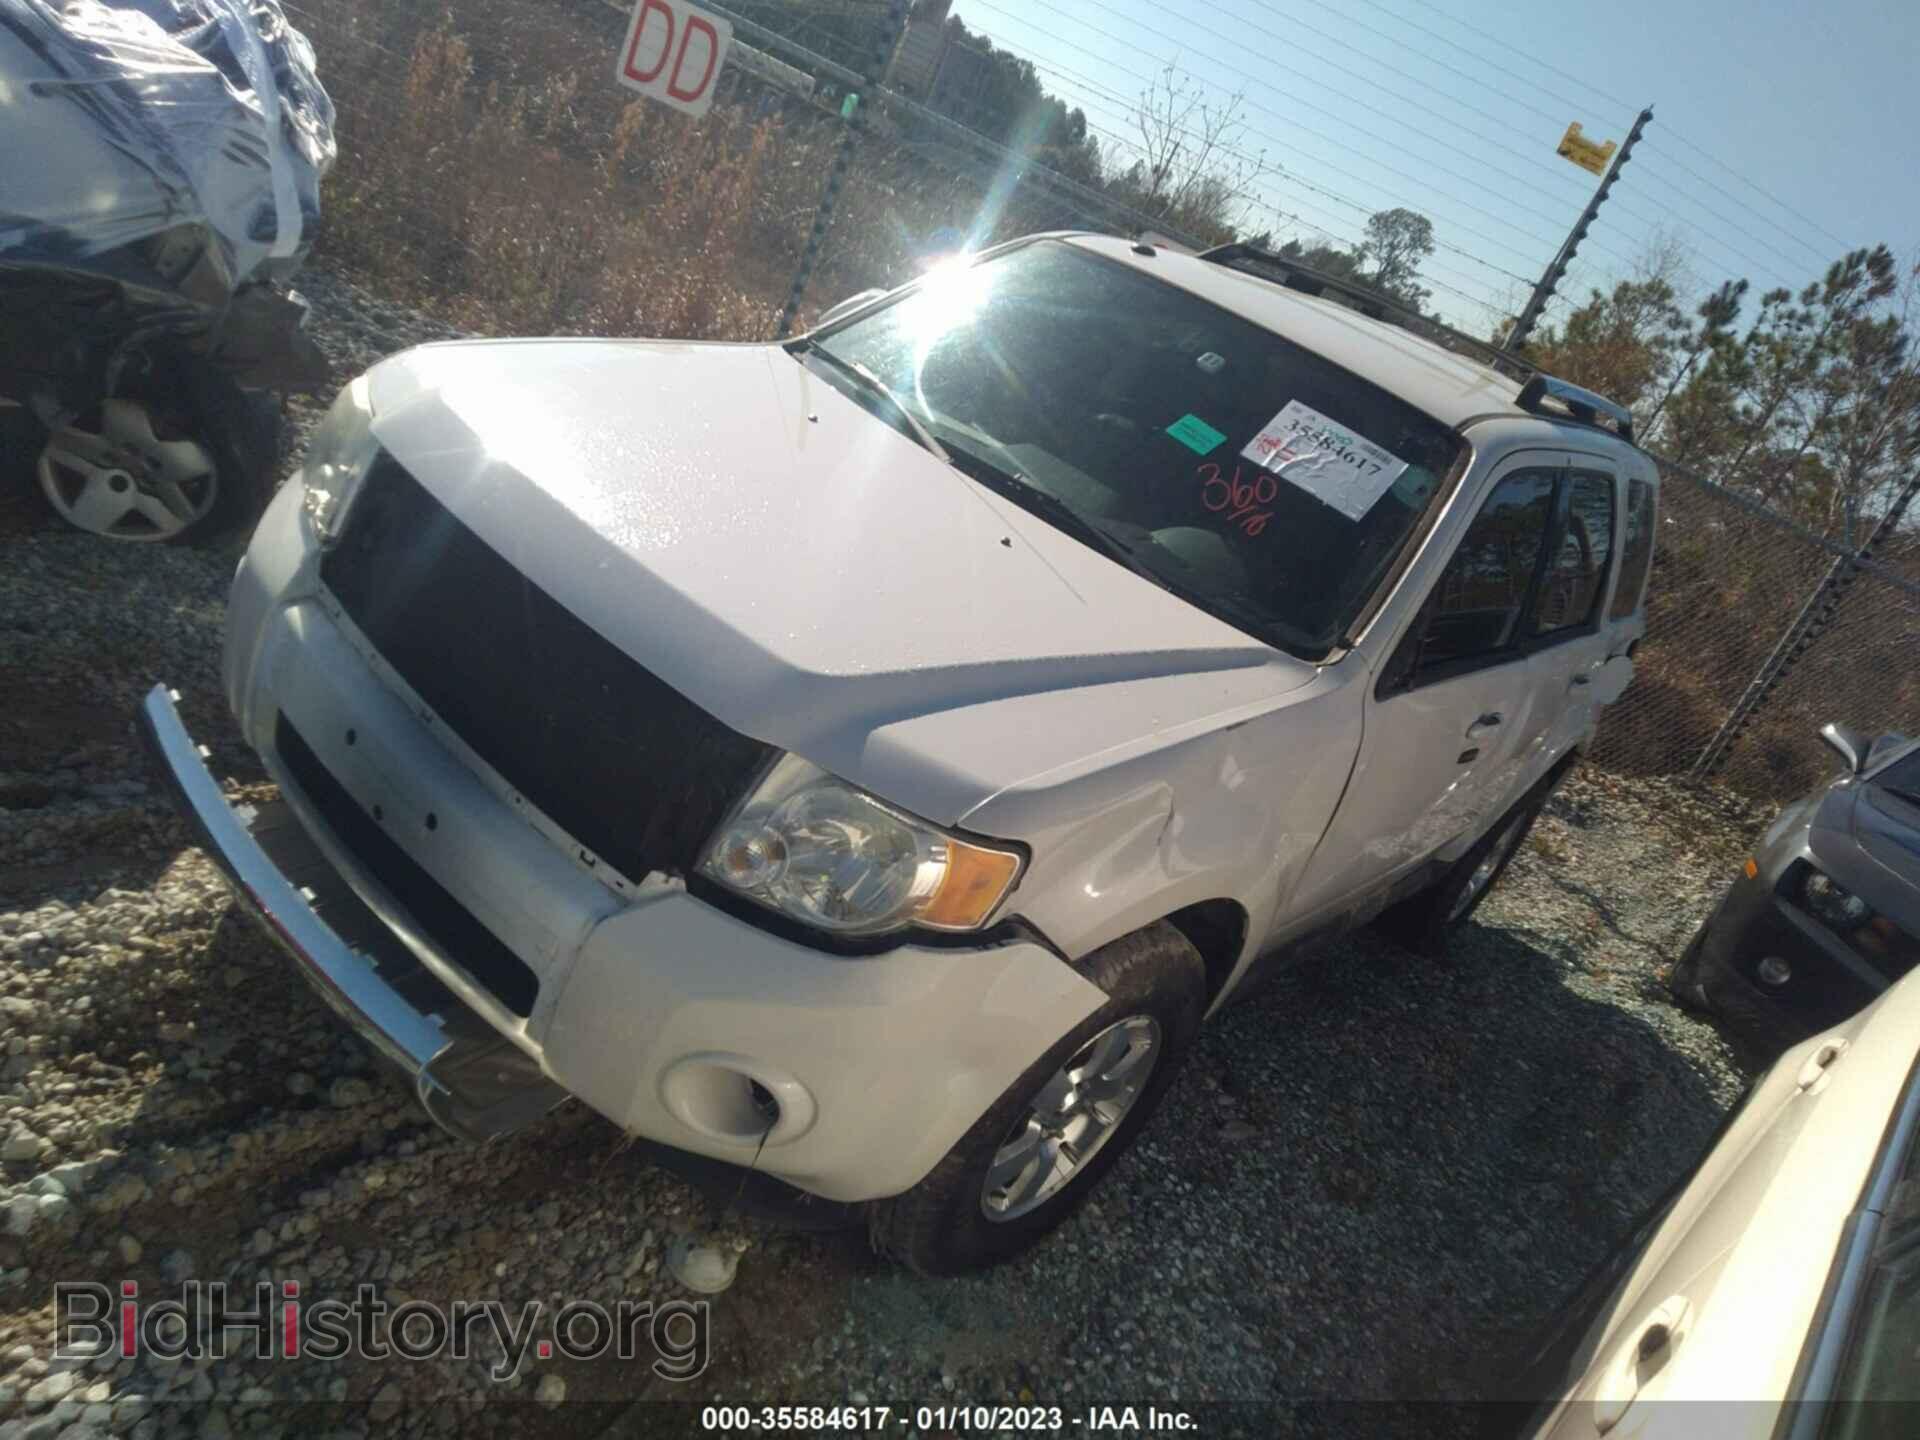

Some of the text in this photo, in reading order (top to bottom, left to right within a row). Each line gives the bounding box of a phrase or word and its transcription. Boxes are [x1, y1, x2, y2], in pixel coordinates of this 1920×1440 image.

[623, 0, 718, 102] DD
[1283, 418, 1382, 476] 35584617
[1197, 463, 1277, 511] 360
